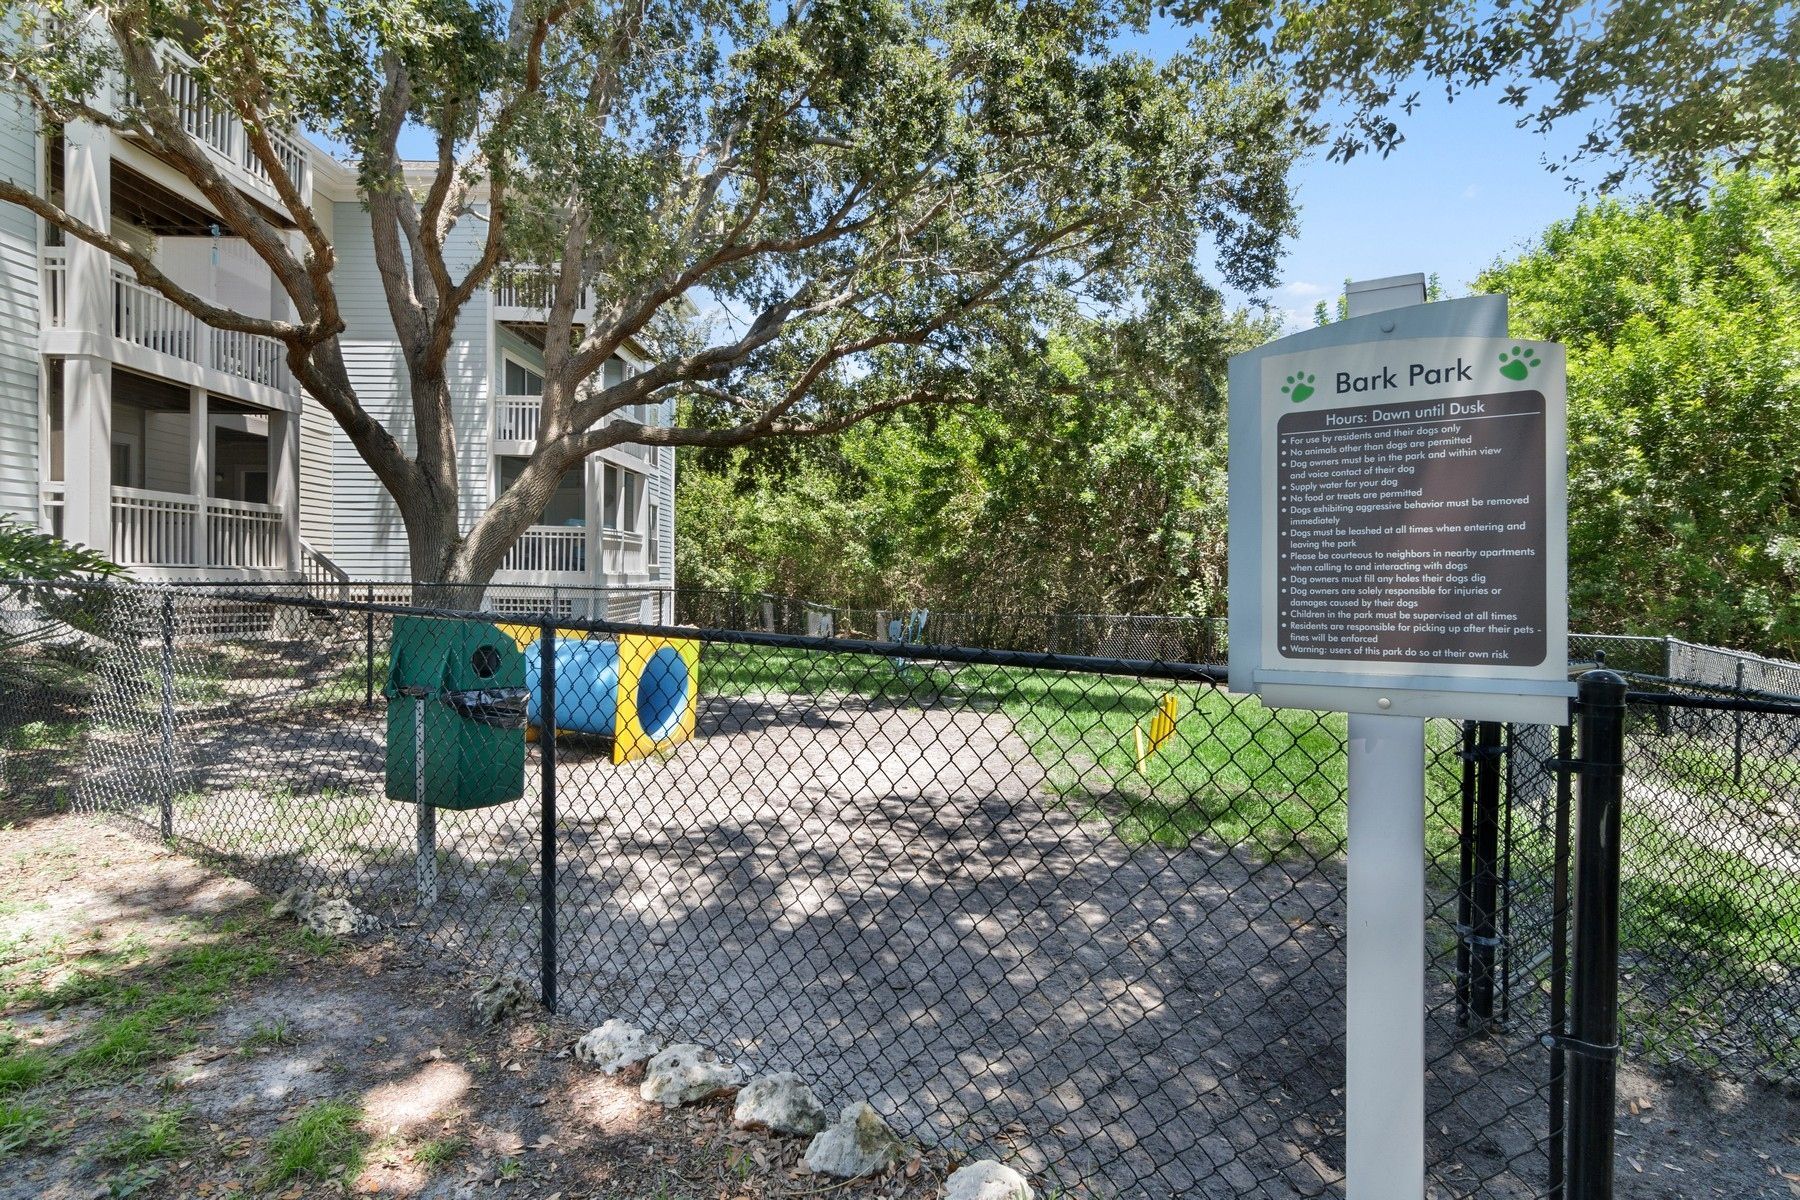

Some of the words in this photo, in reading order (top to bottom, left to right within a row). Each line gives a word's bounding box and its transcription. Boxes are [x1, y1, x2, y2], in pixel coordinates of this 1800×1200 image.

[1336, 366, 1398, 393] Bark
[1410, 358, 1473, 386] Park
[1326, 414, 1367, 426] Hours:
[1372, 410, 1410, 422] Dawn
[1415, 403, 1445, 418] until
[1450, 400, 1485, 415] Dusk
[1290, 437, 1304, 445] For
[1322, 434, 1332, 444] by
[1334, 432, 1372, 441] residents
[1374, 429, 1391, 438] and
[1393, 427, 1414, 437] their
[1416, 426, 1439, 436] dogs
[1441, 423, 1461, 434] only
[1290, 448, 1303, 456] No
[1304, 445, 1337, 455] animals
[1339, 444, 1362, 453] other
[1364, 443, 1384, 451] than
[1386, 441, 1408, 451] dogs
[1428, 435, 1472, 448] permitted
[1290, 460, 1307, 469] Dog
[1309, 459, 1339, 467] owners
[1341, 456, 1362, 464] must
[1364, 455, 1375, 463] be
[1377, 454, 1386, 462] in
[1388, 453, 1403, 461] the
[1405, 450, 1426, 462] park
[1428, 449, 1446, 459] and
[1448, 447, 1477, 457] within
[1479, 446, 1502, 455] view
[1290, 470, 1306, 479] and
[1308, 469, 1329, 478] voice
[1331, 468, 1362, 477] contact
[1364, 466, 1373, 475] of
[1375, 465, 1395, 474] their
[1397, 464, 1415, 474] dog
[1290, 482, 1317, 492] Supply
[1319, 481, 1343, 489] water
[1344, 479, 1357, 488] for
[1359, 480, 1379, 489] your
[1381, 477, 1398, 487] dog
[1304, 492, 1324, 502] food
[1337, 492, 1361, 500] treats
[1380, 487, 1423, 500] permitted
[1290, 506, 1311, 515] Dogs
[1313, 504, 1354, 514] exhibiting
[1355, 501, 1402, 513] aggressive
[1404, 499, 1444, 509] behavior
[1446, 499, 1469, 507] must
[1471, 497, 1484, 506] be
[1487, 495, 1529, 505] removed
[1290, 515, 1340, 526] immediately
[1290, 529, 1311, 539] Dogs
[1313, 528, 1333, 536] must
[1335, 527, 1346, 536] be
[1348, 526, 1382, 535] leashed
[1384, 526, 1393, 534] at
[1395, 525, 1407, 534] all
[1409, 525, 1433, 533] times
[1435, 523, 1461, 532] when
[1464, 522, 1504, 533] entering
[1506, 521, 1526, 530] and
[1290, 540, 1320, 550] leaving
[1321, 539, 1335, 548] the
[1337, 538, 1357, 549] park
[1290, 552, 1316, 560] Please
[1318, 551, 1329, 560] be
[1375, 551, 1384, 559] to
[1386, 549, 1431, 560] neighbors
[1433, 549, 1442, 557] in
[1444, 548, 1477, 559] nearby
[1480, 548, 1535, 558] apartments
[1290, 563, 1312, 572] when
[1314, 563, 1342, 573] calling
[1355, 562, 1372, 571] and
[1374, 562, 1421, 572] interacting
[1423, 561, 1443, 570] with
[1445, 561, 1468, 572] dogs
[1290, 575, 1307, 585] Dog
[1341, 575, 1362, 583] must
[1364, 574, 1375, 582] fill
[1377, 576, 1394, 584] any
[1396, 574, 1420, 583] holes
[1422, 573, 1444, 583] their
[1445, 573, 1468, 584] dogs
[1471, 573, 1486, 584] dig
[1290, 587, 1307, 597] Dog
[1358, 586, 1383, 597] solely
[1385, 586, 1436, 596] responsible
[1438, 586, 1452, 595] for
[1454, 586, 1489, 597] injuries
[1290, 598, 1328, 608] damages
[1329, 598, 1359, 607] caused
[1361, 598, 1372, 608] by
[1374, 598, 1395, 607] their
[1396, 598, 1418, 609] dogs
[1290, 609, 1325, 618] Children
[1327, 610, 1335, 618] in
[1337, 610, 1351, 619] the
[1353, 610, 1373, 620] park
[1399, 610, 1411, 619] be
[1413, 611, 1461, 621] supervised
[1464, 612, 1474, 620] at
[1476, 611, 1488, 620] all
[1491, 611, 1517, 621] times
[1290, 621, 1328, 630] Residents
[1346, 622, 1396, 633] responsible
[1398, 622, 1411, 631] for
[1413, 623, 1446, 634] picking
[1448, 626, 1461, 634] up
[1463, 623, 1486, 633] after
[1488, 624, 1511, 633] their
[1513, 626, 1534, 635] pets
[1290, 632, 1310, 642] fines
[1311, 633, 1326, 642] will
[1328, 633, 1338, 642] be
[1340, 634, 1378, 643] enforced
[1290, 644, 1327, 655] Warning:
[1353, 646, 1363, 655] of
[1365, 646, 1380, 655] this
[1382, 647, 1403, 657] park
[1405, 647, 1417, 656] do
[1432, 649, 1442, 657] at
[1444, 648, 1466, 658] their
[1491, 650, 1509, 659] risk
